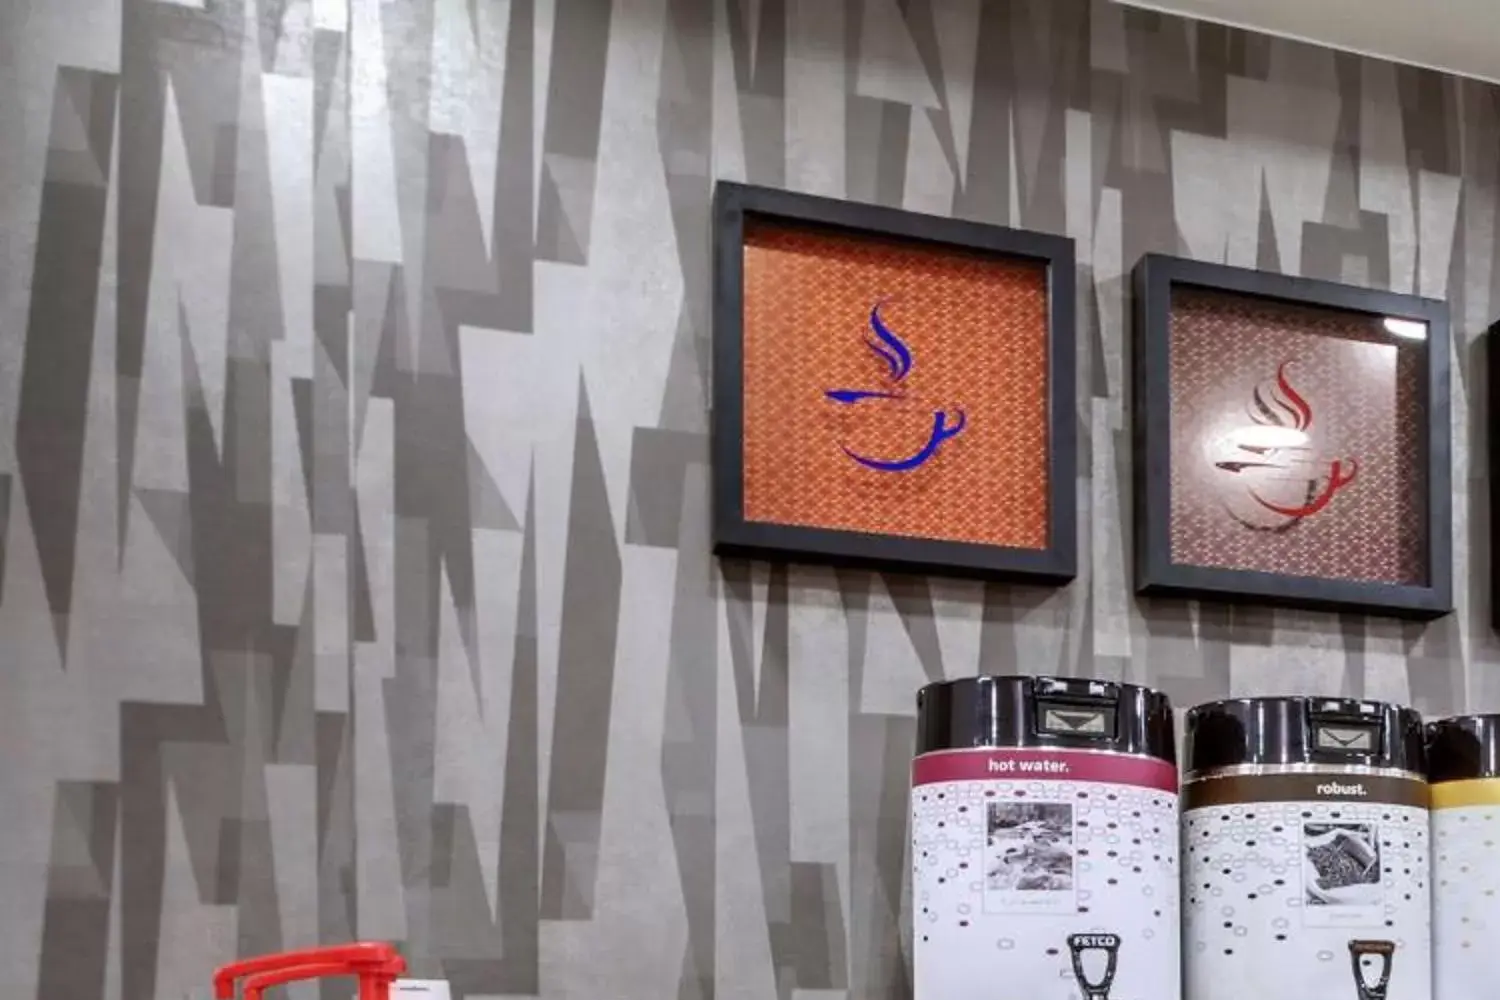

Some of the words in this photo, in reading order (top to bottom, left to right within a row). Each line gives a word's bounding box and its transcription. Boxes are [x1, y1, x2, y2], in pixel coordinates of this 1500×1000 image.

[988, 757, 1015, 772] hot
[1019, 759, 1069, 773] water.
[1317, 781, 1368, 796] robust.
